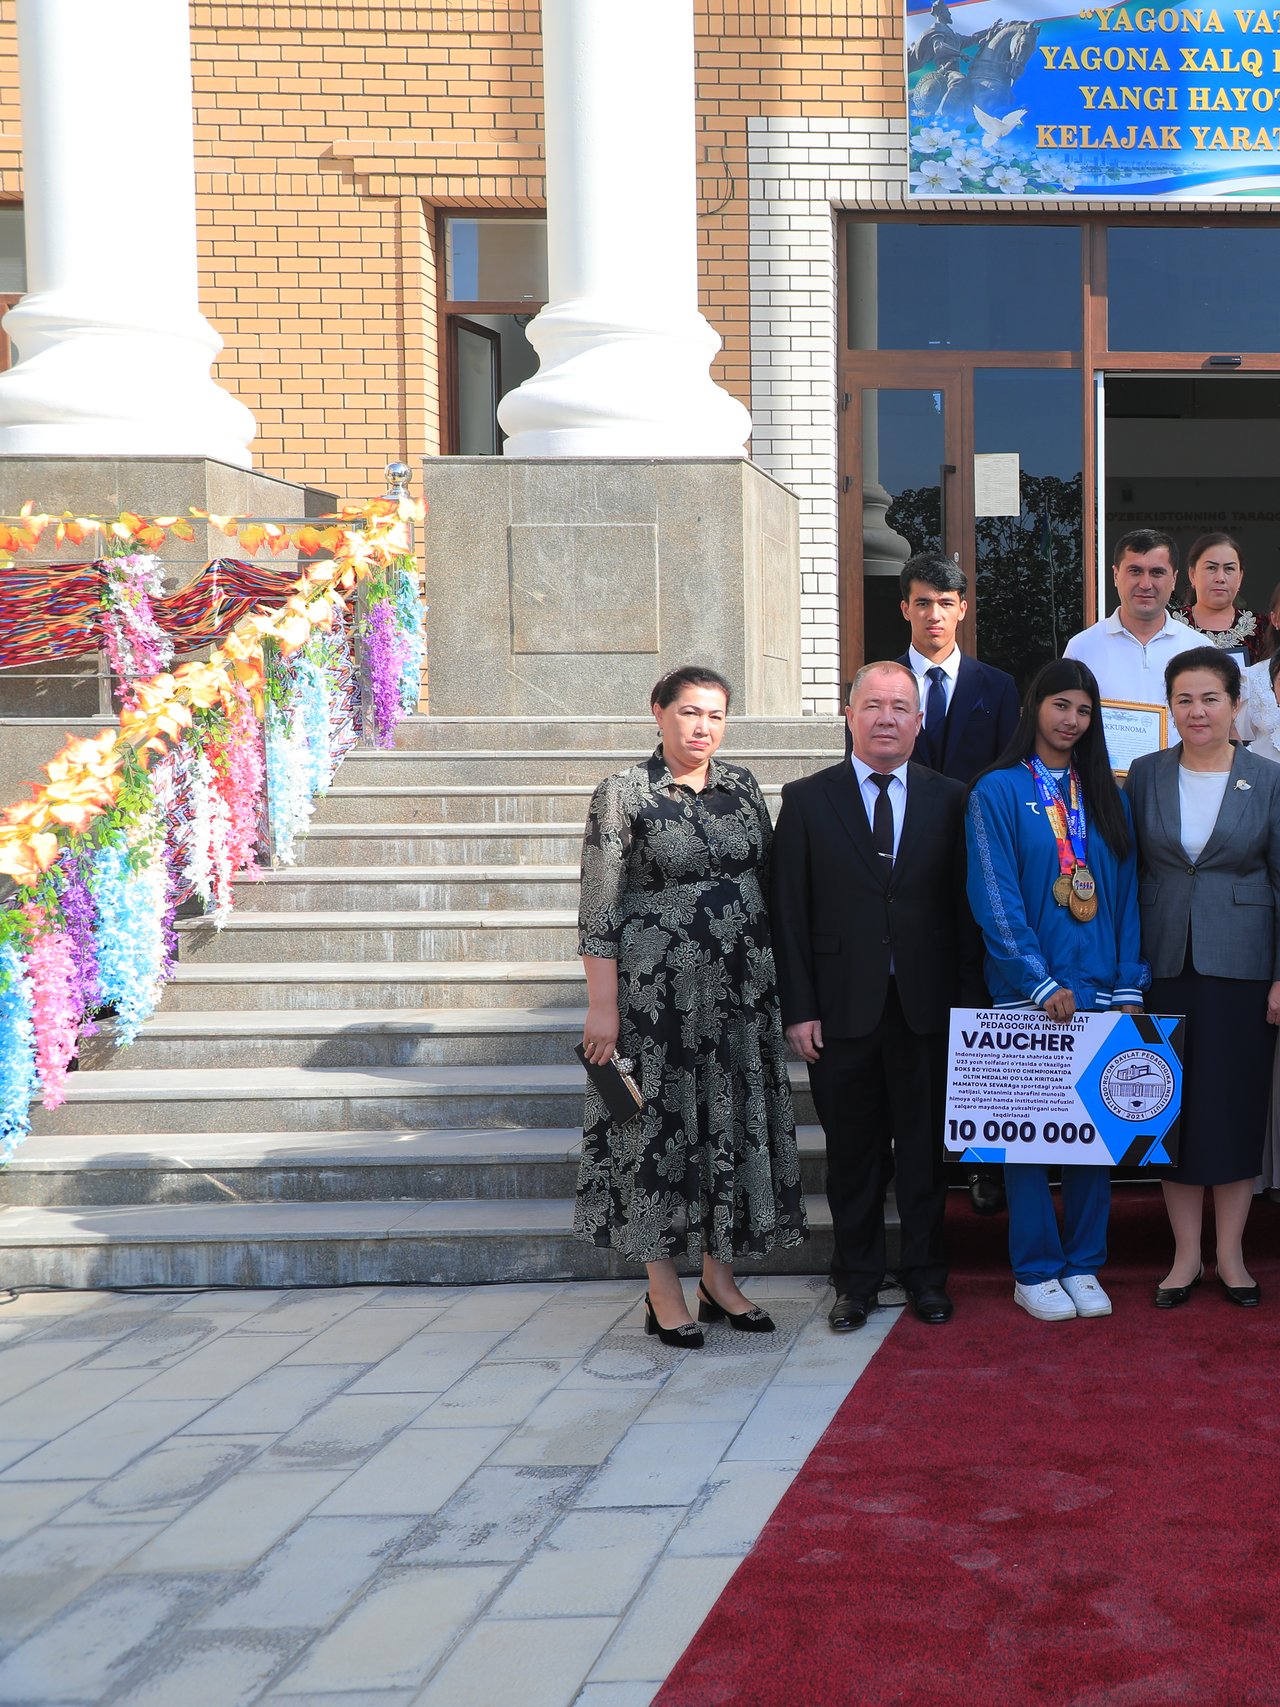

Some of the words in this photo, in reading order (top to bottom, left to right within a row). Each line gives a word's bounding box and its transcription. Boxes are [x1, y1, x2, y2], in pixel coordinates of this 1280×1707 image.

[1079, 8, 1224, 33] “YAGONA
[1039, 46, 1171, 71] YAGONA
[1179, 48, 1263, 78] XALQ
[1079, 86, 1178, 111] YANGI
[1035, 125, 1182, 150] KELAJAK
[980, 1021, 1041, 1031] PEDAGOGIKA
[1042, 1023, 1085, 1032] INSTITUTI
[961, 1031, 1075, 1052] VAUCHER
[1115, 1052, 1139, 1064] DAVLAT
[1142, 1052, 1172, 1085] PEDAGOGIKA
[1150, 1086, 1172, 1115] INSTITUTI
[948, 1119, 977, 1141] 10
[983, 1120, 1037, 1143] 000
[1043, 1122, 1096, 1144] 000
